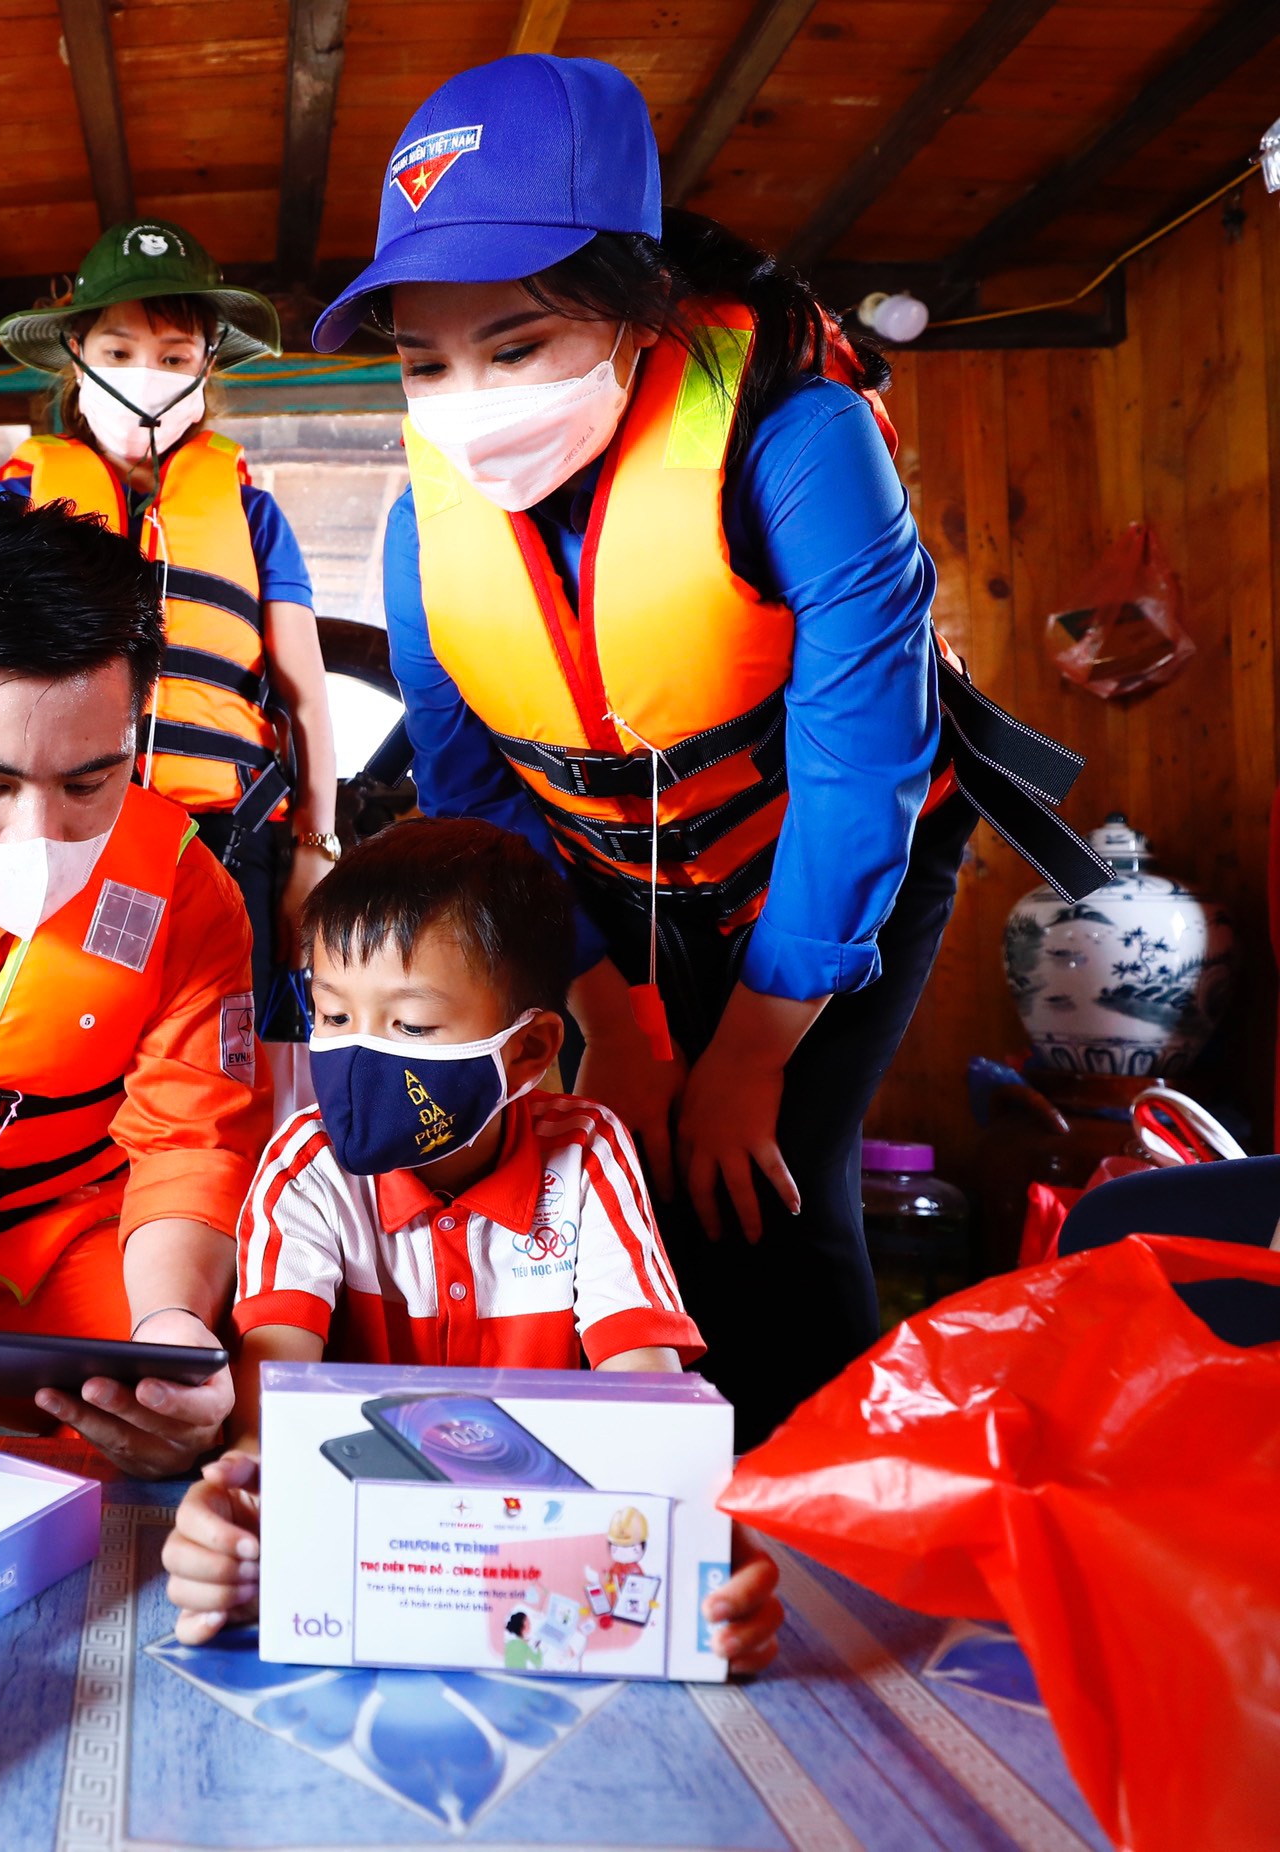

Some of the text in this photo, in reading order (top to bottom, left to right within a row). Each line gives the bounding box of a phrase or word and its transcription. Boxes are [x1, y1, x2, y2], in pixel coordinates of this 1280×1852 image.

[427, 137, 450, 158] VIỆT
[451, 133, 476, 150] NAM
[404, 1069, 422, 1089] A
[530, 1264, 552, 1279] HỌC
[388, 1537, 499, 1556] CHƯƠNG TRÌNH
[292, 1612, 342, 1637] tab
